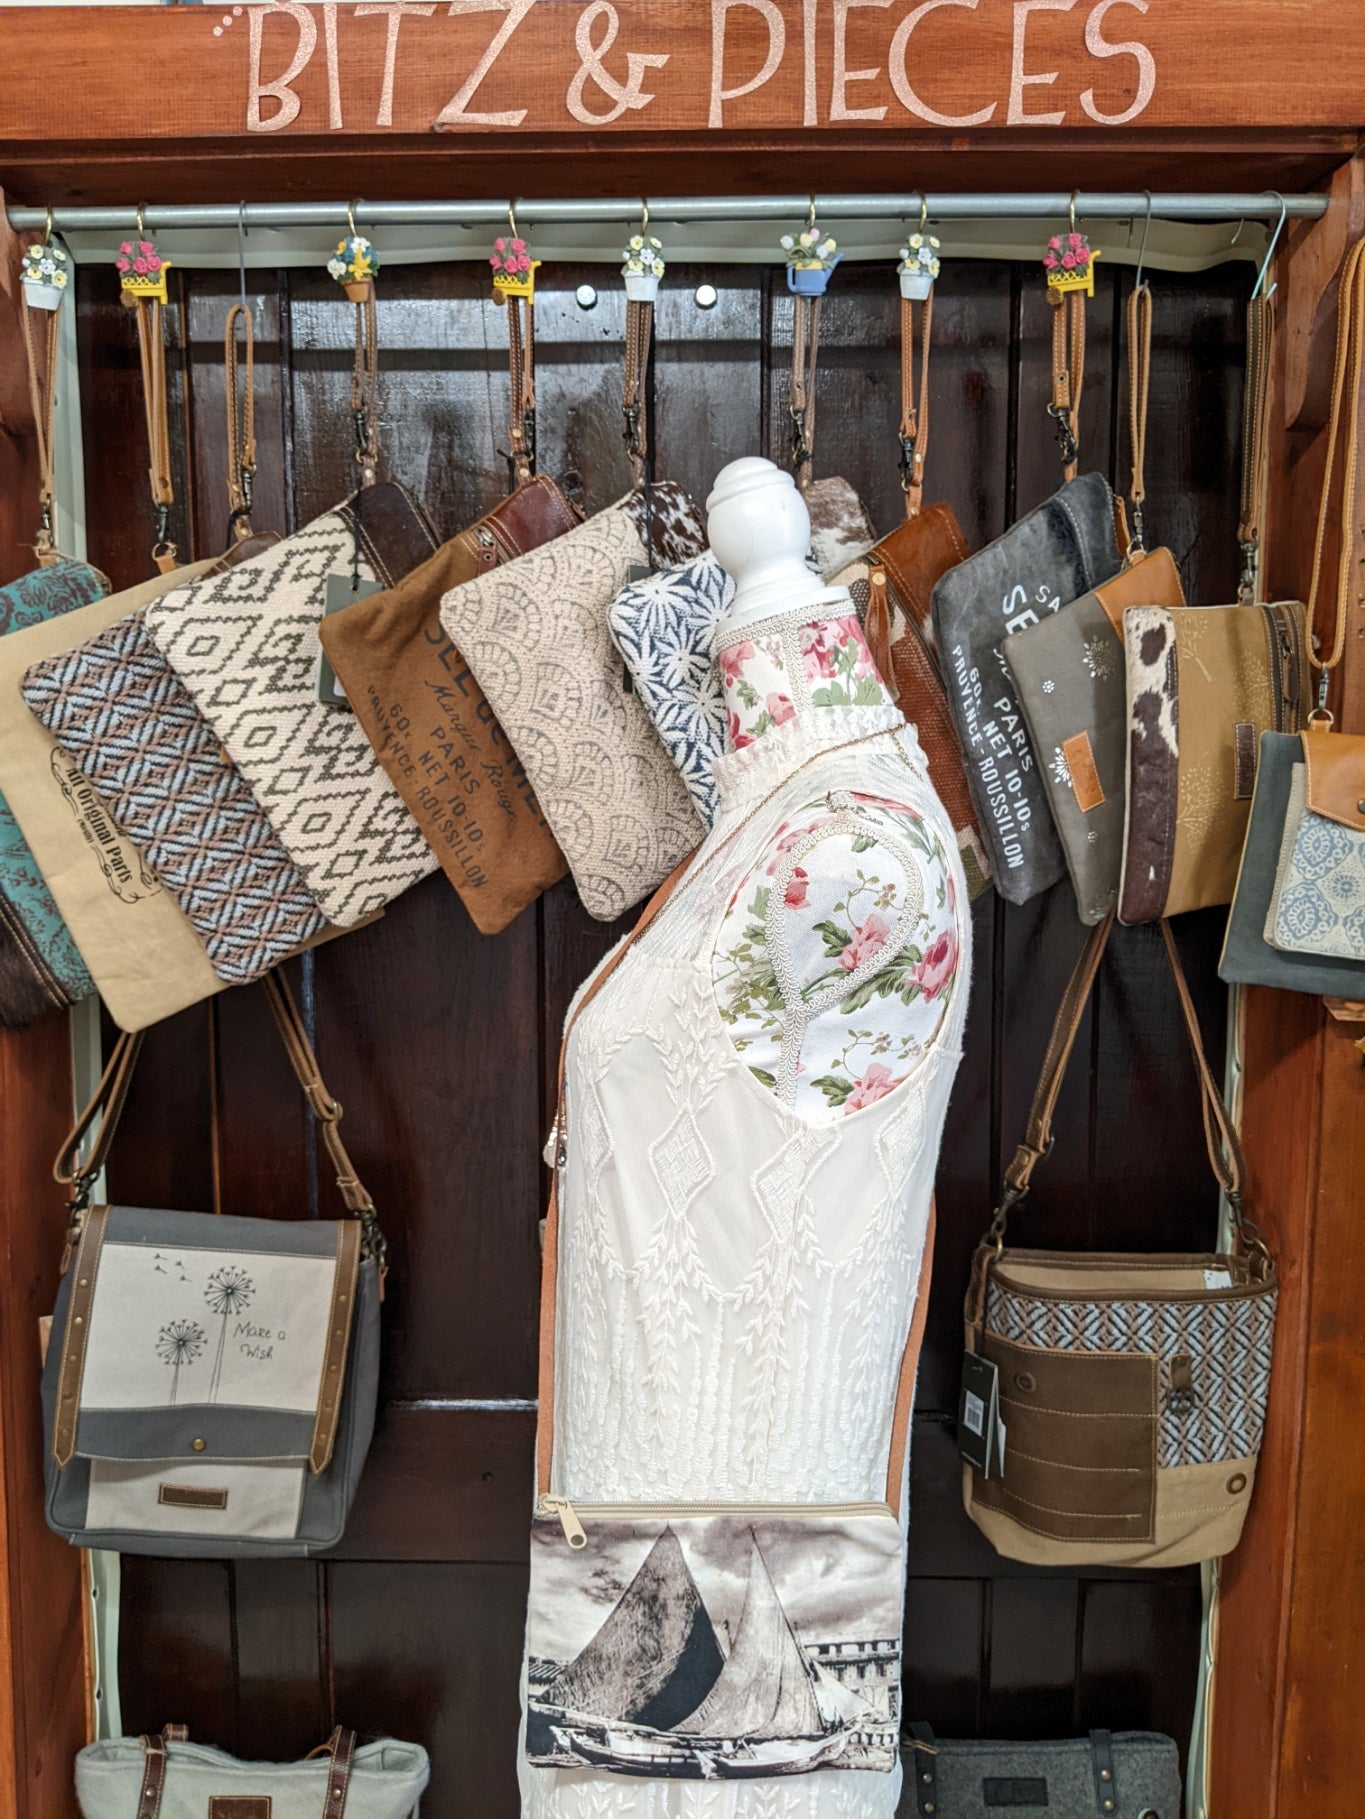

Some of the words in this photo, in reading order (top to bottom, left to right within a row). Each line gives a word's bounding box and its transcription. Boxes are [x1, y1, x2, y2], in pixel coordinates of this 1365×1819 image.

[566, 0, 671, 126] &
[708, 0, 1156, 128] PIECES
[430, 727, 480, 795] PARIS
[983, 721, 1012, 760] NET
[993, 696, 1033, 772] PARIS
[418, 751, 449, 786] NET
[66, 768, 86, 787] All
[77, 788, 116, 845] Original
[106, 846, 133, 884] Parts
[978, 759, 1024, 869] ROUSSILLON
[240, 1344, 274, 1360] Wish
[277, 1330, 286, 1340] a
